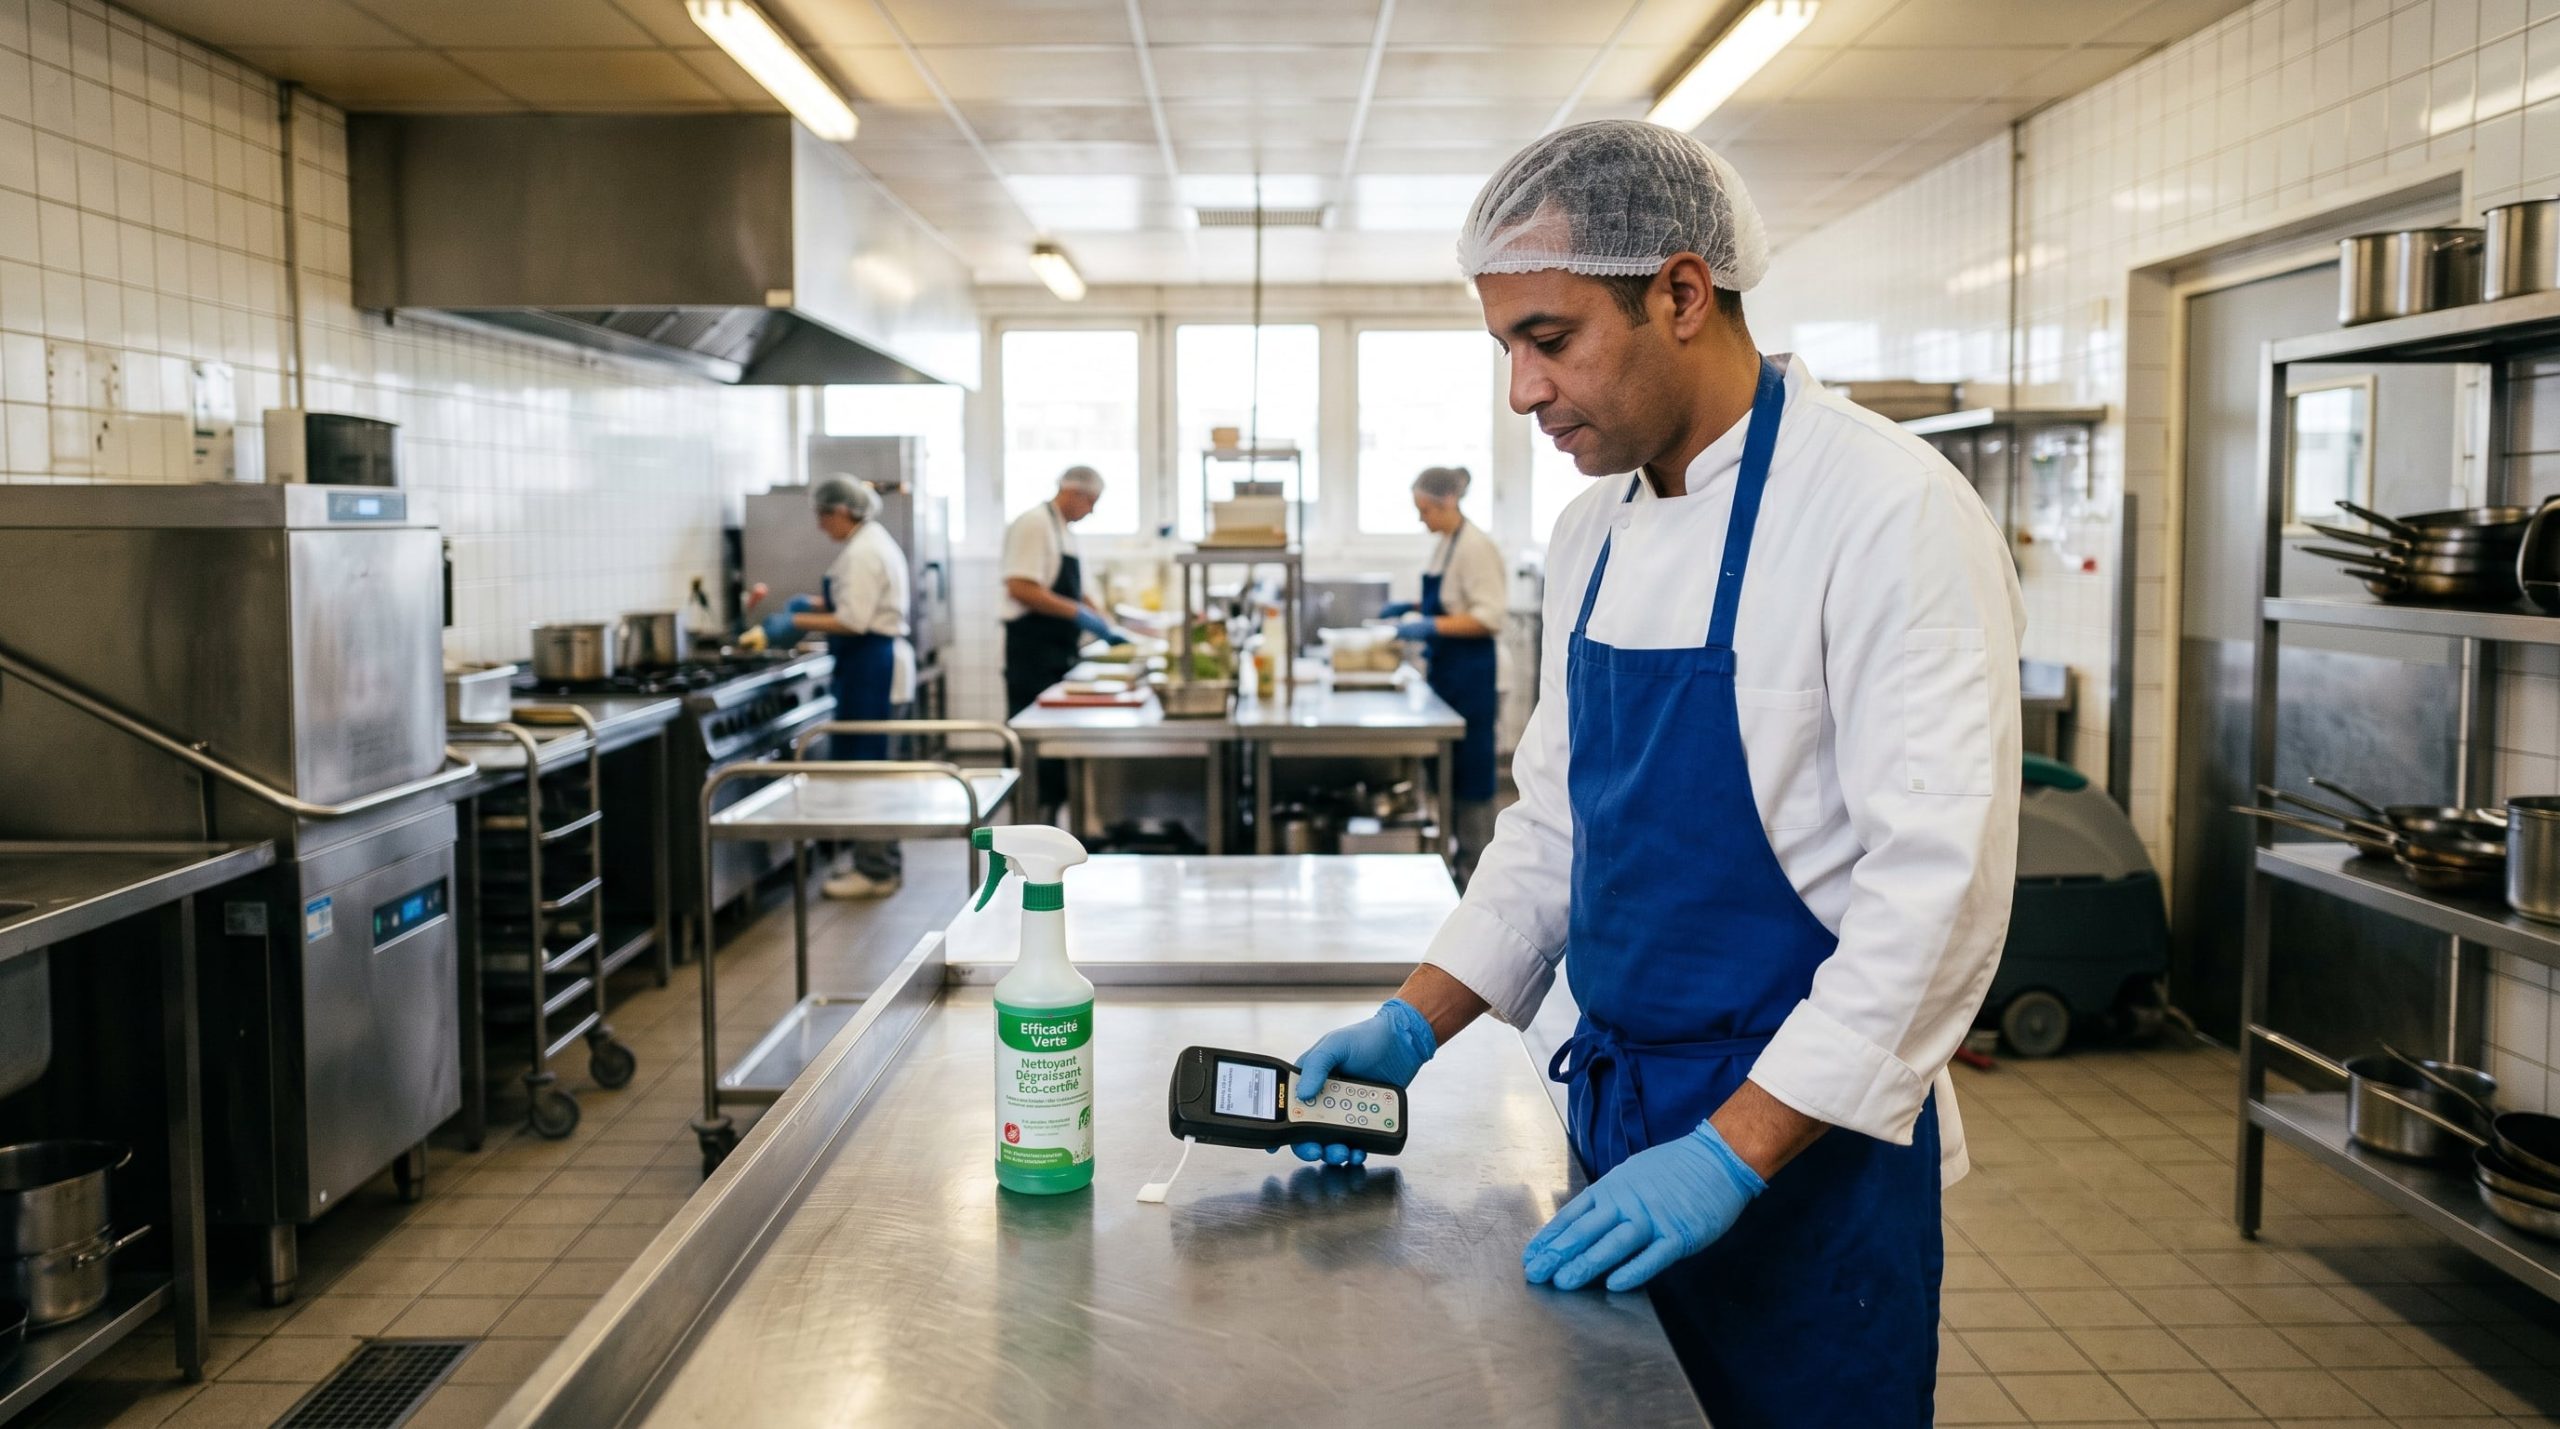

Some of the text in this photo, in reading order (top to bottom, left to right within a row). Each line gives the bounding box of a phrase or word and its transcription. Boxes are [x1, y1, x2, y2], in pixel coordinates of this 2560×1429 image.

[1020, 1019, 1078, 1035] Efficacité
[1031, 1036, 1068, 1048] Verte
[1021, 1055, 1077, 1072] Nettoyant
[1016, 1066, 1082, 1084] Dégraissant
